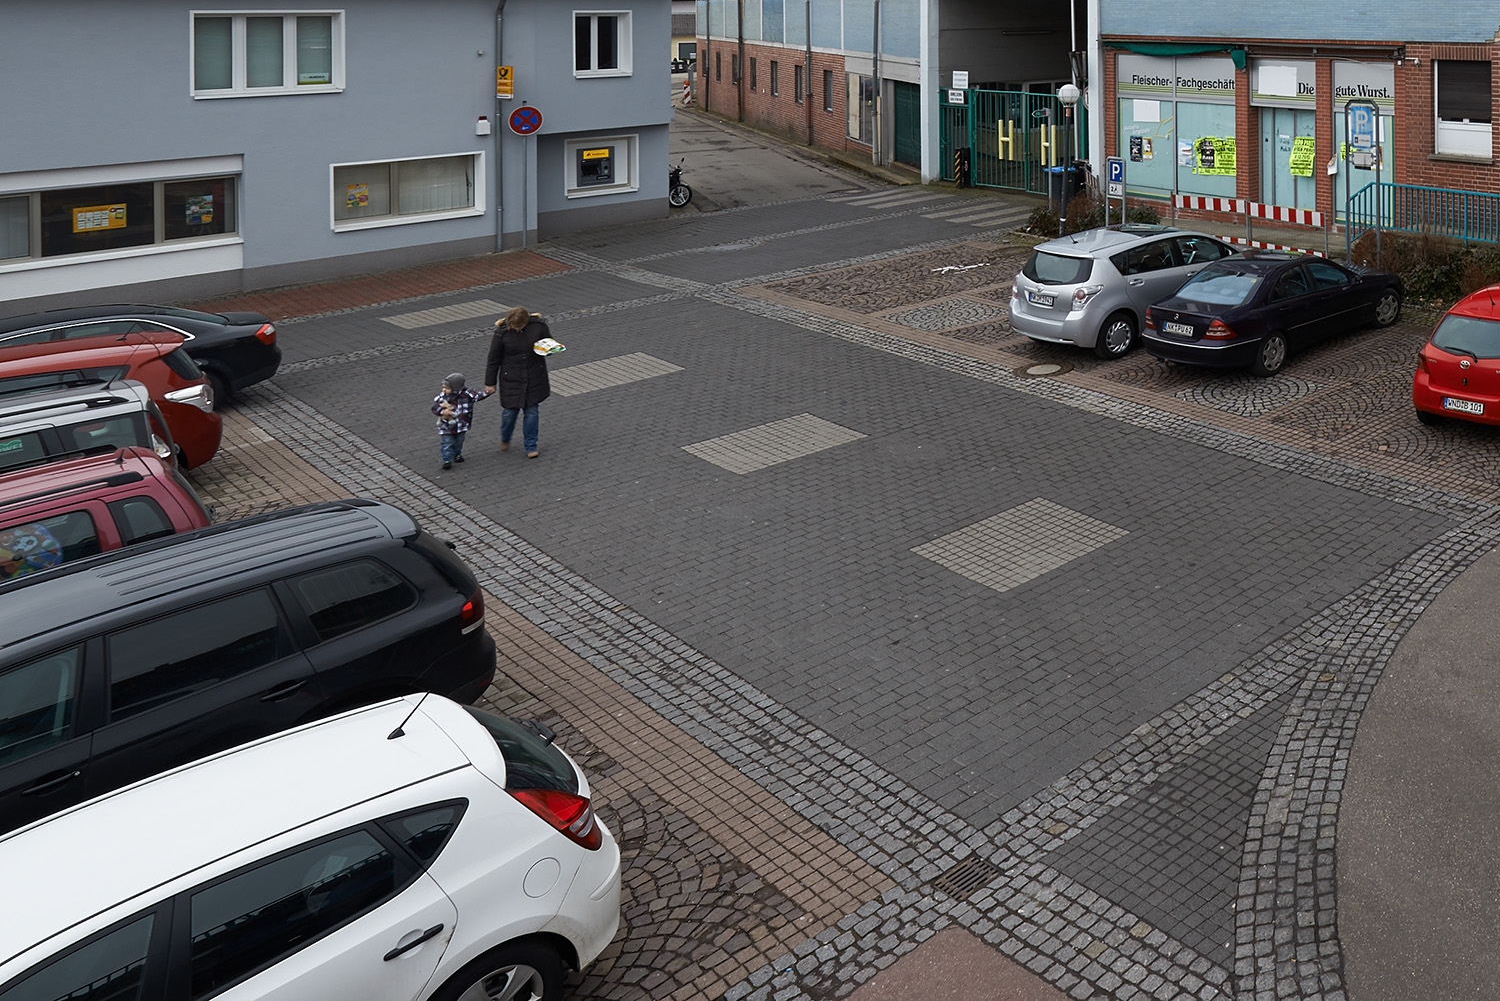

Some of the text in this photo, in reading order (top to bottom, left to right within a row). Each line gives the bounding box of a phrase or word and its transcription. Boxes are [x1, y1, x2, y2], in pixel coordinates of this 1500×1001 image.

[1132, 74, 1236, 91] Fleischer- Fachgeschäft
[1298, 82, 1390, 99] Die gute Wurst.
[1355, 110, 1369, 135] P
[1112, 163, 1120, 180] P
